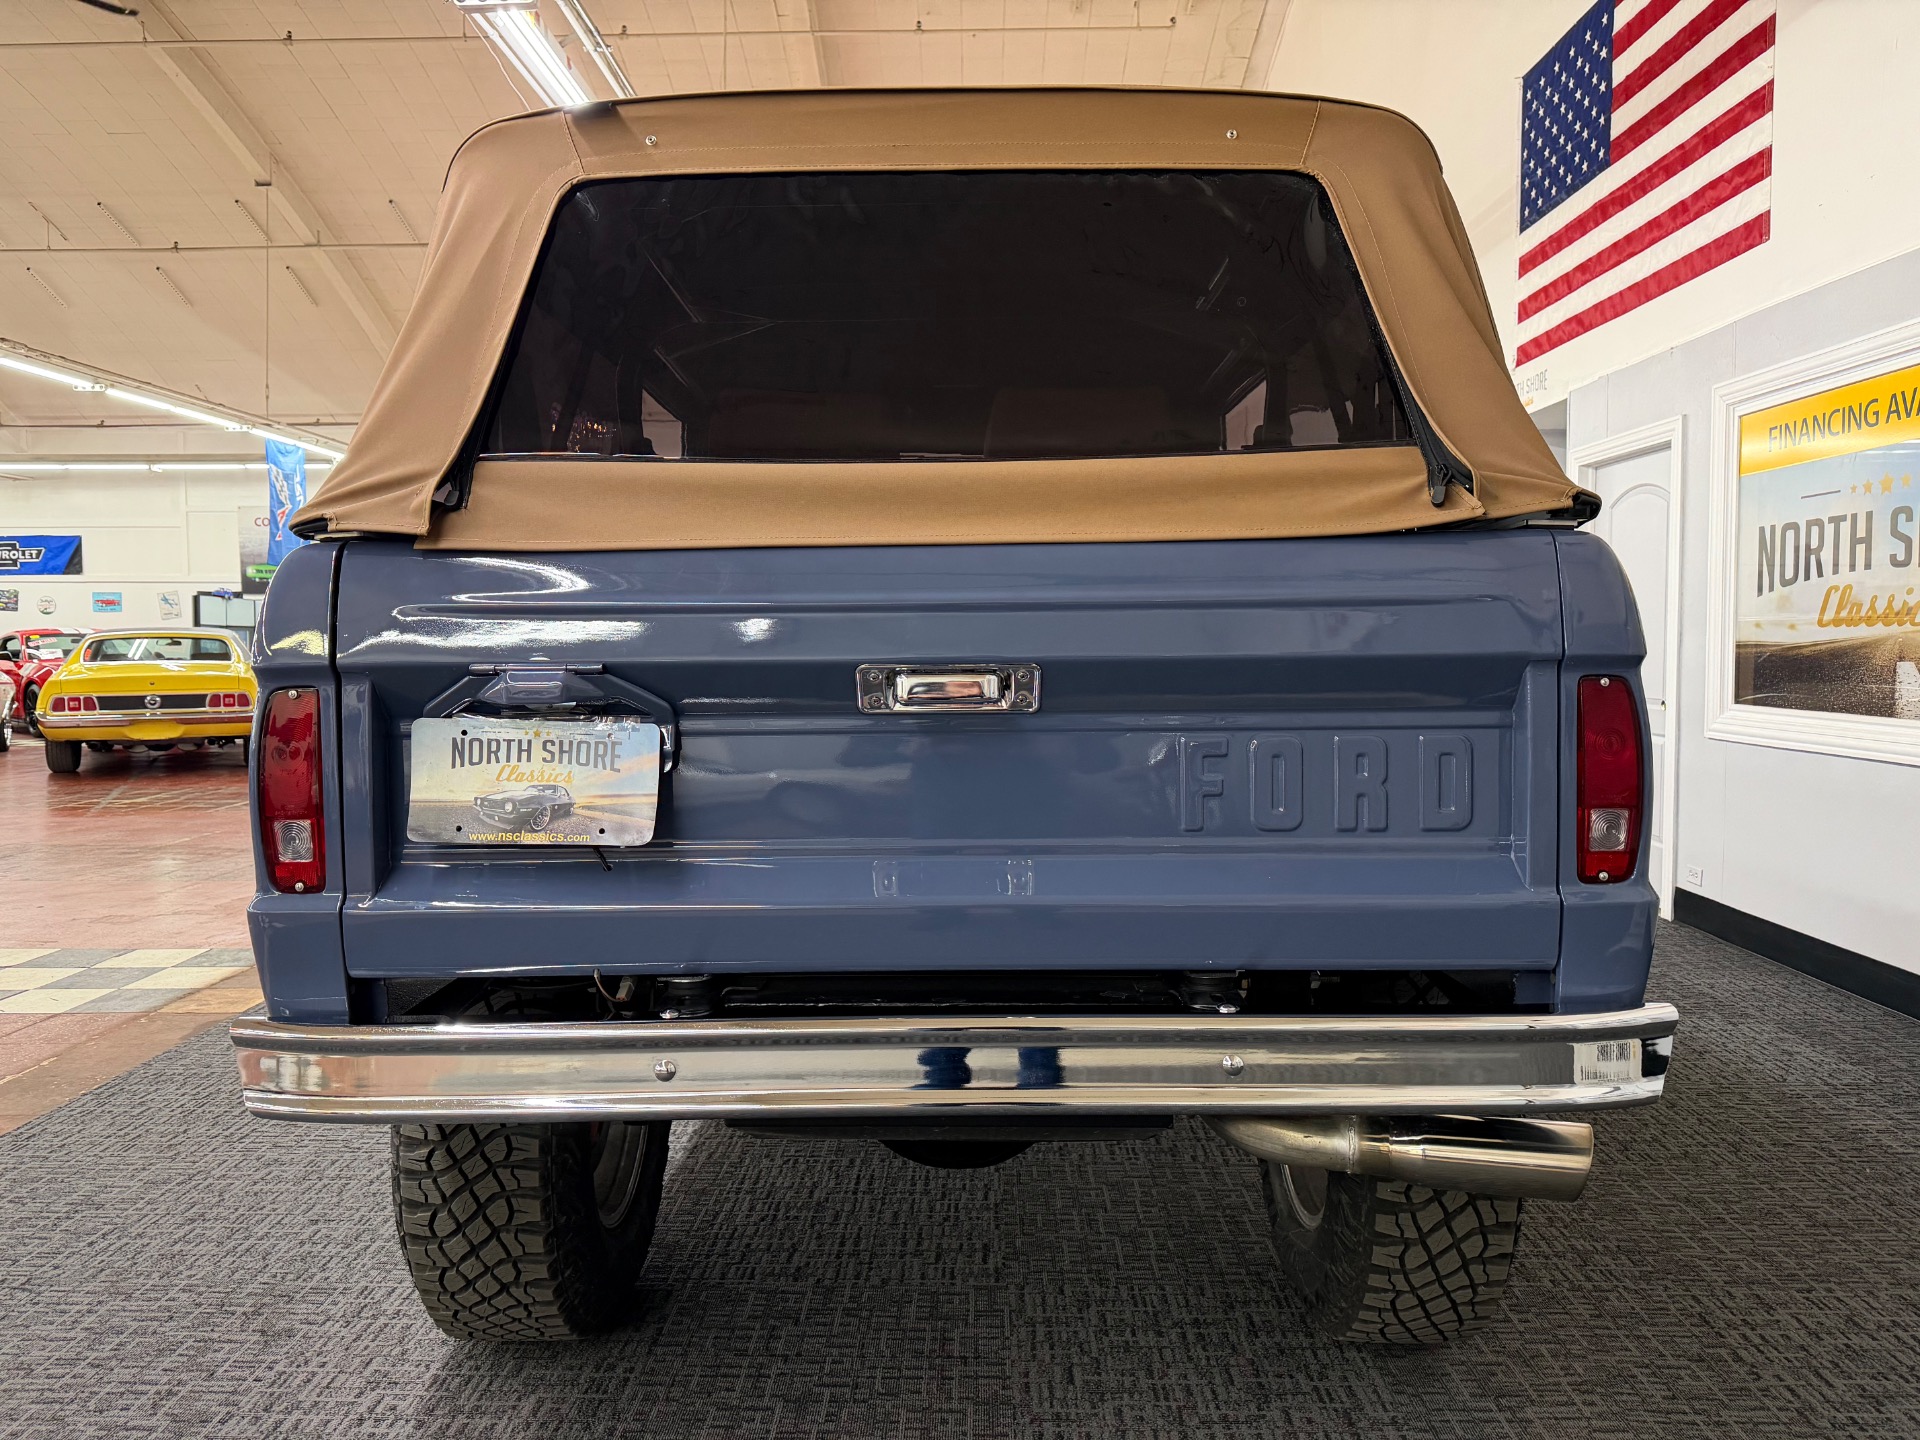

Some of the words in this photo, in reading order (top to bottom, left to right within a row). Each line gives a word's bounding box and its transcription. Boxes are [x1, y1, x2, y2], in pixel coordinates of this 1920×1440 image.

[1526, 369, 1548, 394] SHORE
[1768, 398, 1880, 453] FINANCING
[0, 550, 38, 559] ROLET
[1757, 510, 1874, 598] NORTH
[1889, 505, 1920, 568] S
[451, 737, 532, 769] NORTH
[541, 739, 623, 773] SHORE
[495, 763, 574, 784] Classics
[1179, 735, 1474, 832] FORD
[468, 830, 590, 842] www.nsclassics.com
